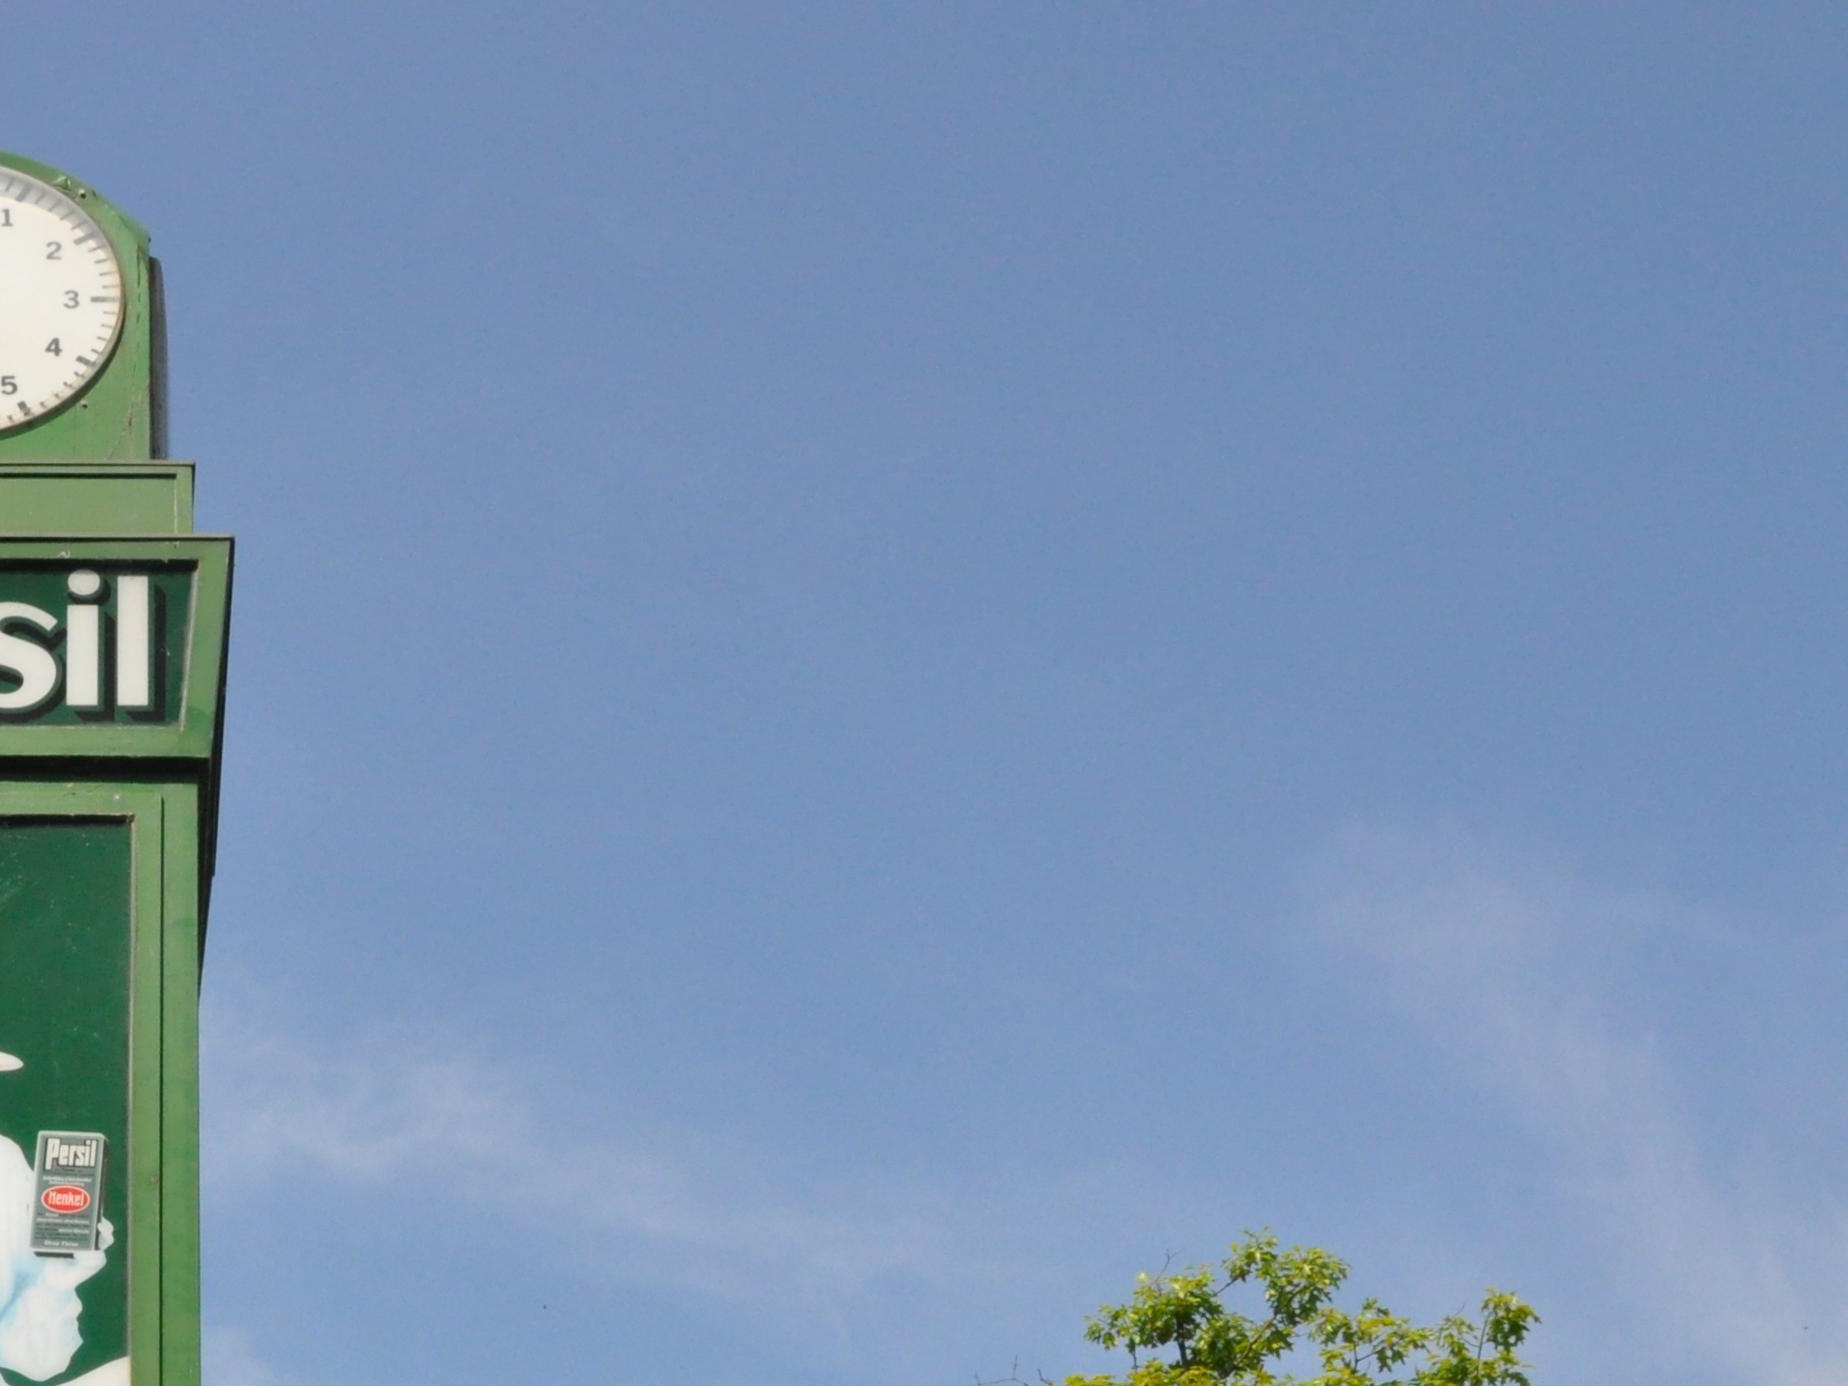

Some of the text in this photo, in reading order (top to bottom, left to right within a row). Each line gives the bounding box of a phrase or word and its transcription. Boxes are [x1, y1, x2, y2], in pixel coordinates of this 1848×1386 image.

[0, 208, 14, 227] 1
[46, 241, 63, 261] 2
[63, 290, 80, 309] 3
[45, 337, 63, 357] 4
[0, 376, 18, 396] 5
[44, 1137, 98, 1170] Persil
[47, 1190, 85, 1207] Henkel
